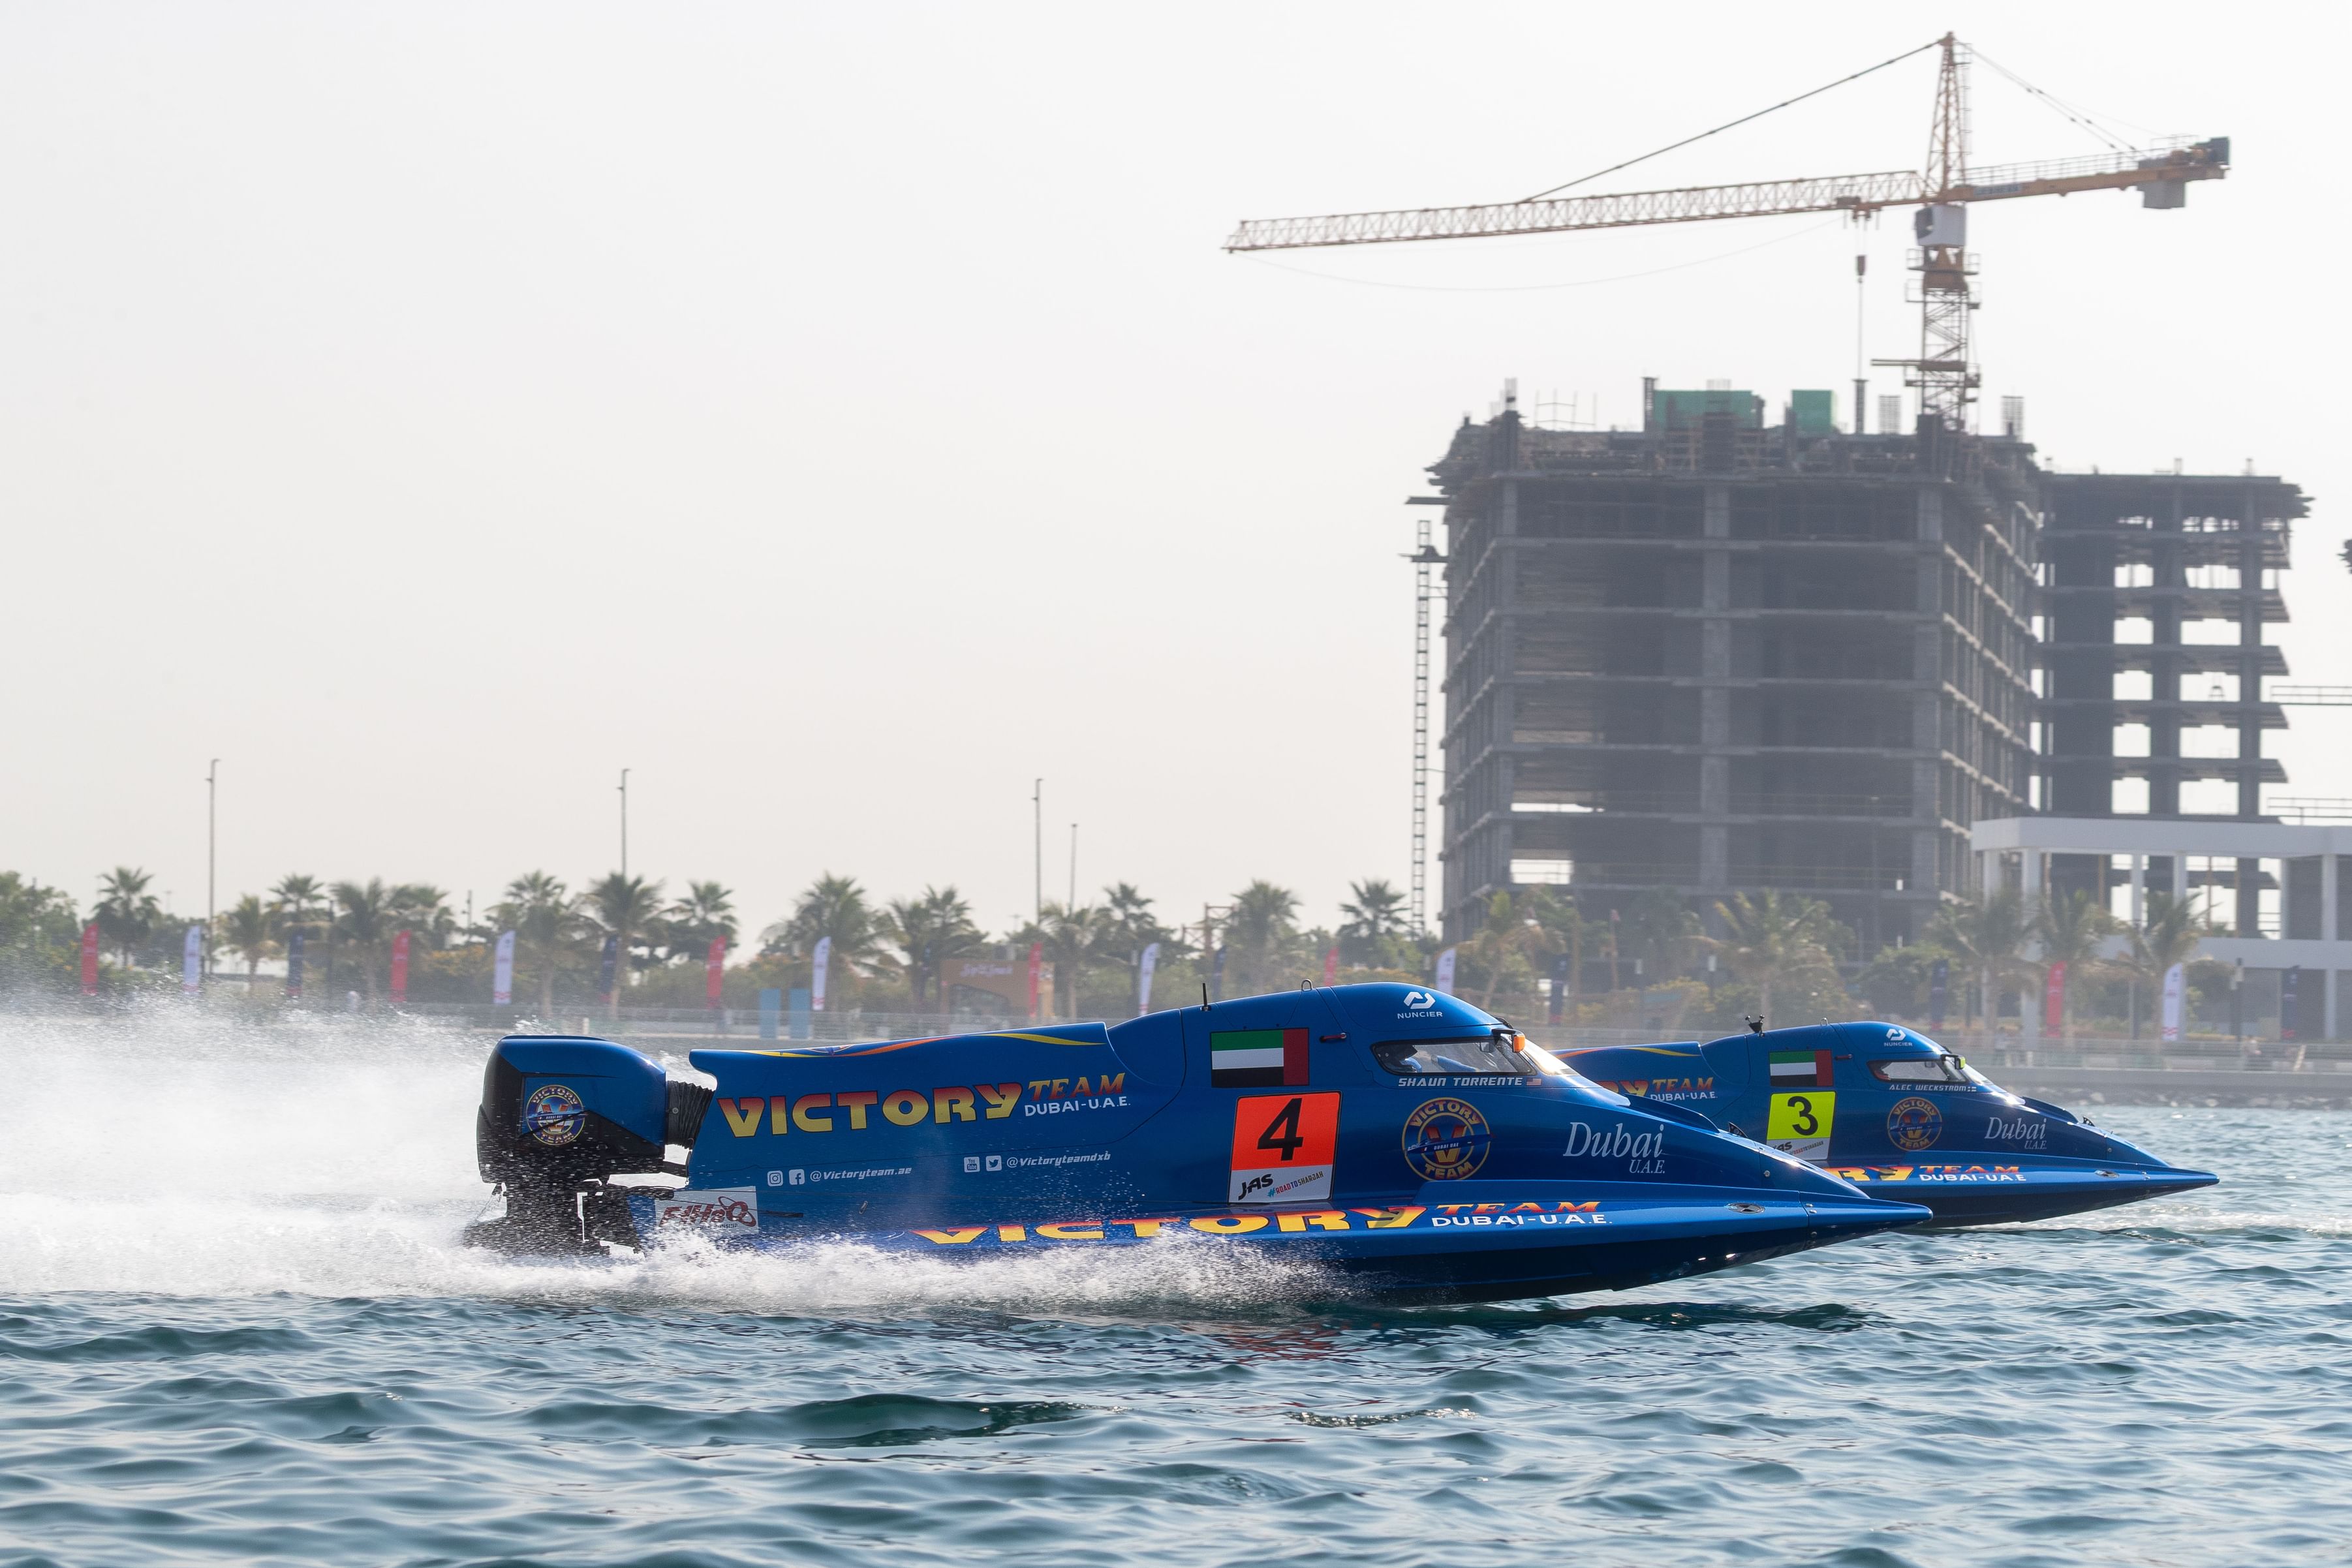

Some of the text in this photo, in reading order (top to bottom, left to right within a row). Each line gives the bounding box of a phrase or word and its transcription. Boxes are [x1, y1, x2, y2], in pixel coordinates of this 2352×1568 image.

[1398, 1077, 1523, 1087] SHAUN TORRENTE
[1652, 1077, 1714, 1093] TEAM
[531, 1086, 579, 1104] VICTORY
[717, 1073, 1126, 1138] VICTORY TEAM
[1024, 1096, 1131, 1116] DUBAI-U.A.E.
[1409, 1101, 1481, 1127] VICTORY
[1893, 1099, 1938, 1116] VICTORY
[1787, 1096, 1819, 1136] 3
[1257, 1098, 1304, 1161] 4
[1985, 1117, 2047, 1139] Dubai
[540, 1131, 574, 1143] TEAM
[1563, 1122, 1664, 1158] Dubai
[1900, 1137, 1930, 1148] TEAM
[1775, 1141, 1793, 1152] AS
[1006, 1152, 1111, 1168] @Victoryteamdxb
[1629, 1160, 1665, 1174] U.A.E.
[810, 1167, 912, 1182] @Victoryteam.ae
[1425, 1161, 1476, 1180] TEAM
[1919, 1165, 2020, 1174] TEAM
[1238, 1174, 1274, 1201] JAS
[908, 1201, 1601, 1244] VICTORY TEAM
[1431, 1214, 1613, 1227] DUBAI-U.A.E.
